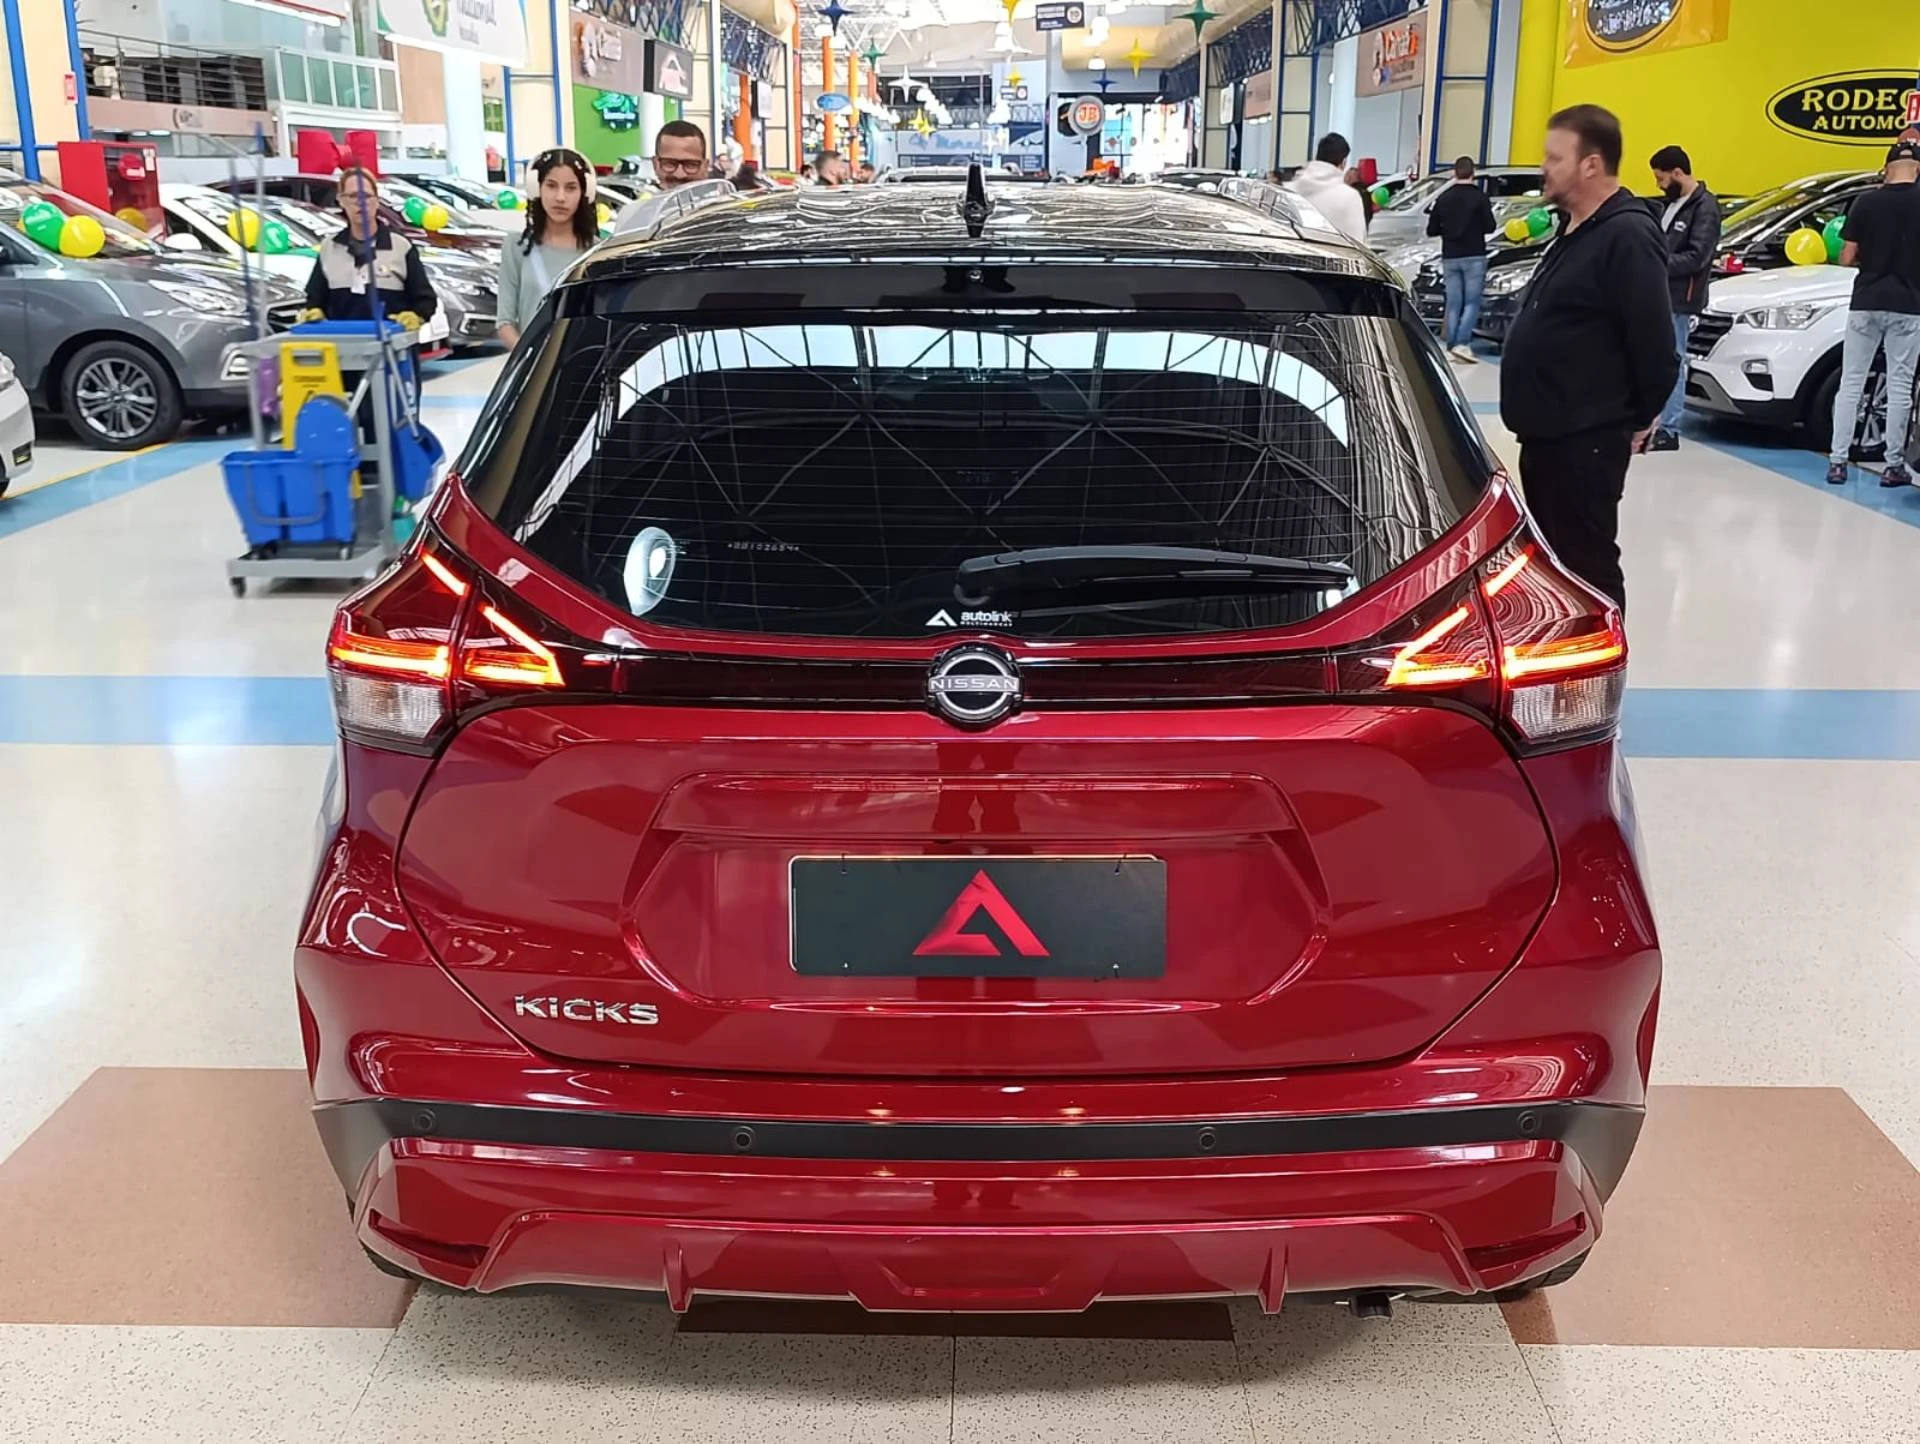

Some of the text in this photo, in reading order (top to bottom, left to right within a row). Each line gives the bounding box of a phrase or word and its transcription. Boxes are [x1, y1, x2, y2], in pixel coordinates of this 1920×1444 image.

[1080, 105, 1098, 122] JB
[960, 610, 1013, 623] autolink
[930, 678, 1018, 690] NISSAN
[514, 995, 659, 1025] KICKS
